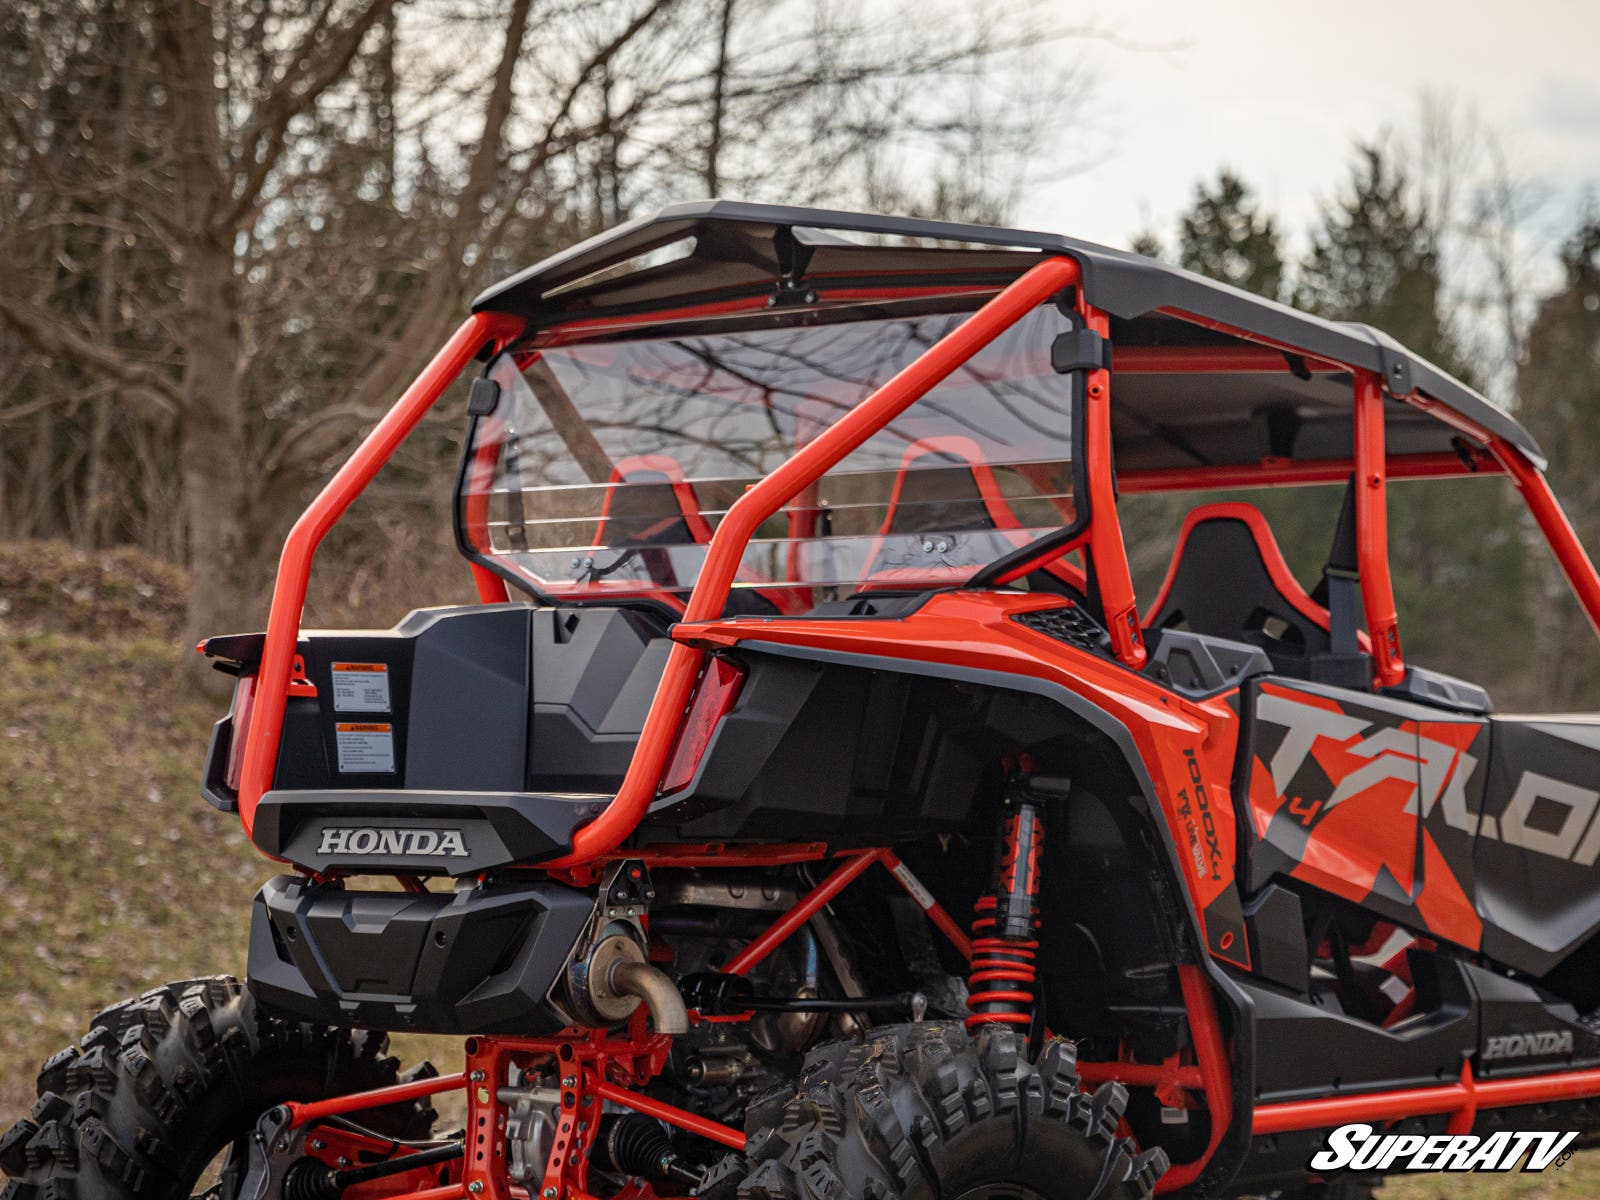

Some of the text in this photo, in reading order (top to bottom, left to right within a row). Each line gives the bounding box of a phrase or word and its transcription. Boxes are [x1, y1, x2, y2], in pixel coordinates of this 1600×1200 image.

[1288, 796, 1322, 826] 4
[317, 828, 469, 857] HONDA
[1482, 1031, 1574, 1060] HONDA
